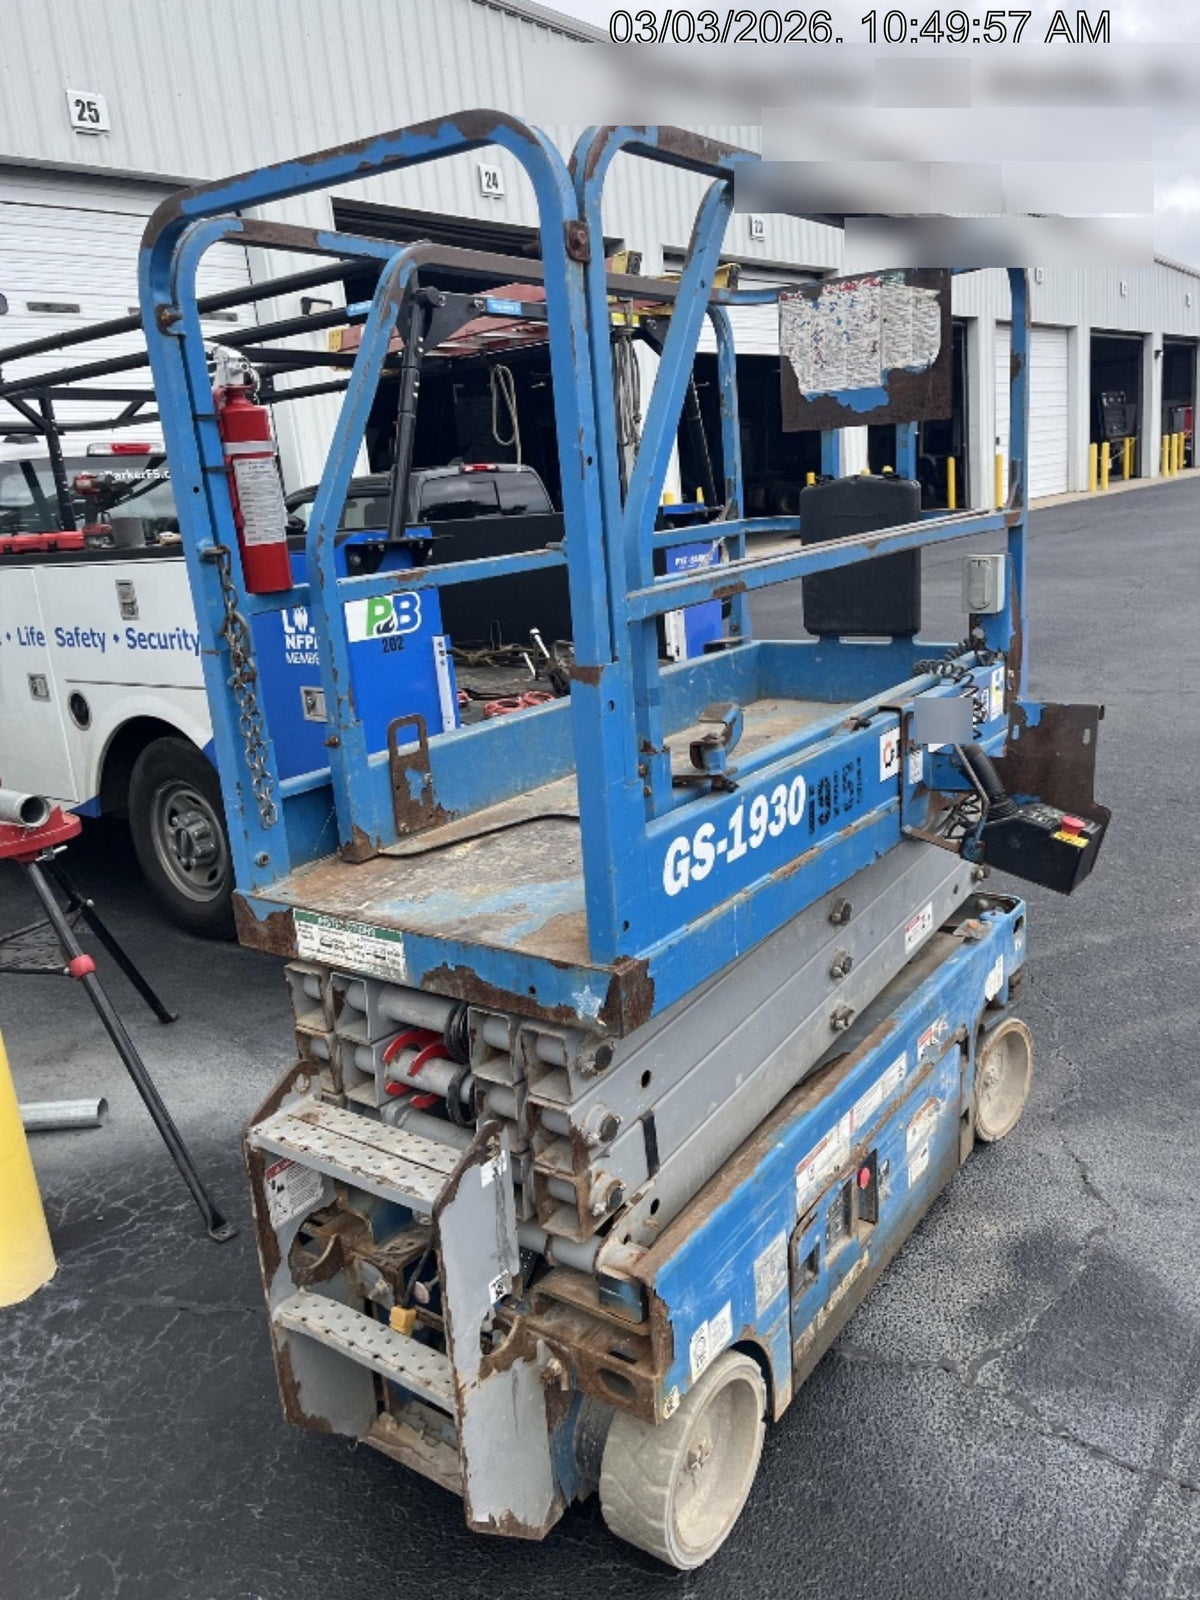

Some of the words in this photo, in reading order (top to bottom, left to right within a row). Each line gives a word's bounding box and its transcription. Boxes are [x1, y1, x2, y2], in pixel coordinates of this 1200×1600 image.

[75, 99, 100, 123] 25
[484, 171, 499, 189] 24
[17, 626, 46, 646] Life
[54, 626, 106, 653] Safety
[125, 626, 200, 656] Security
[381, 636, 405, 653] 202
[663, 774, 806, 896] GS-1930
